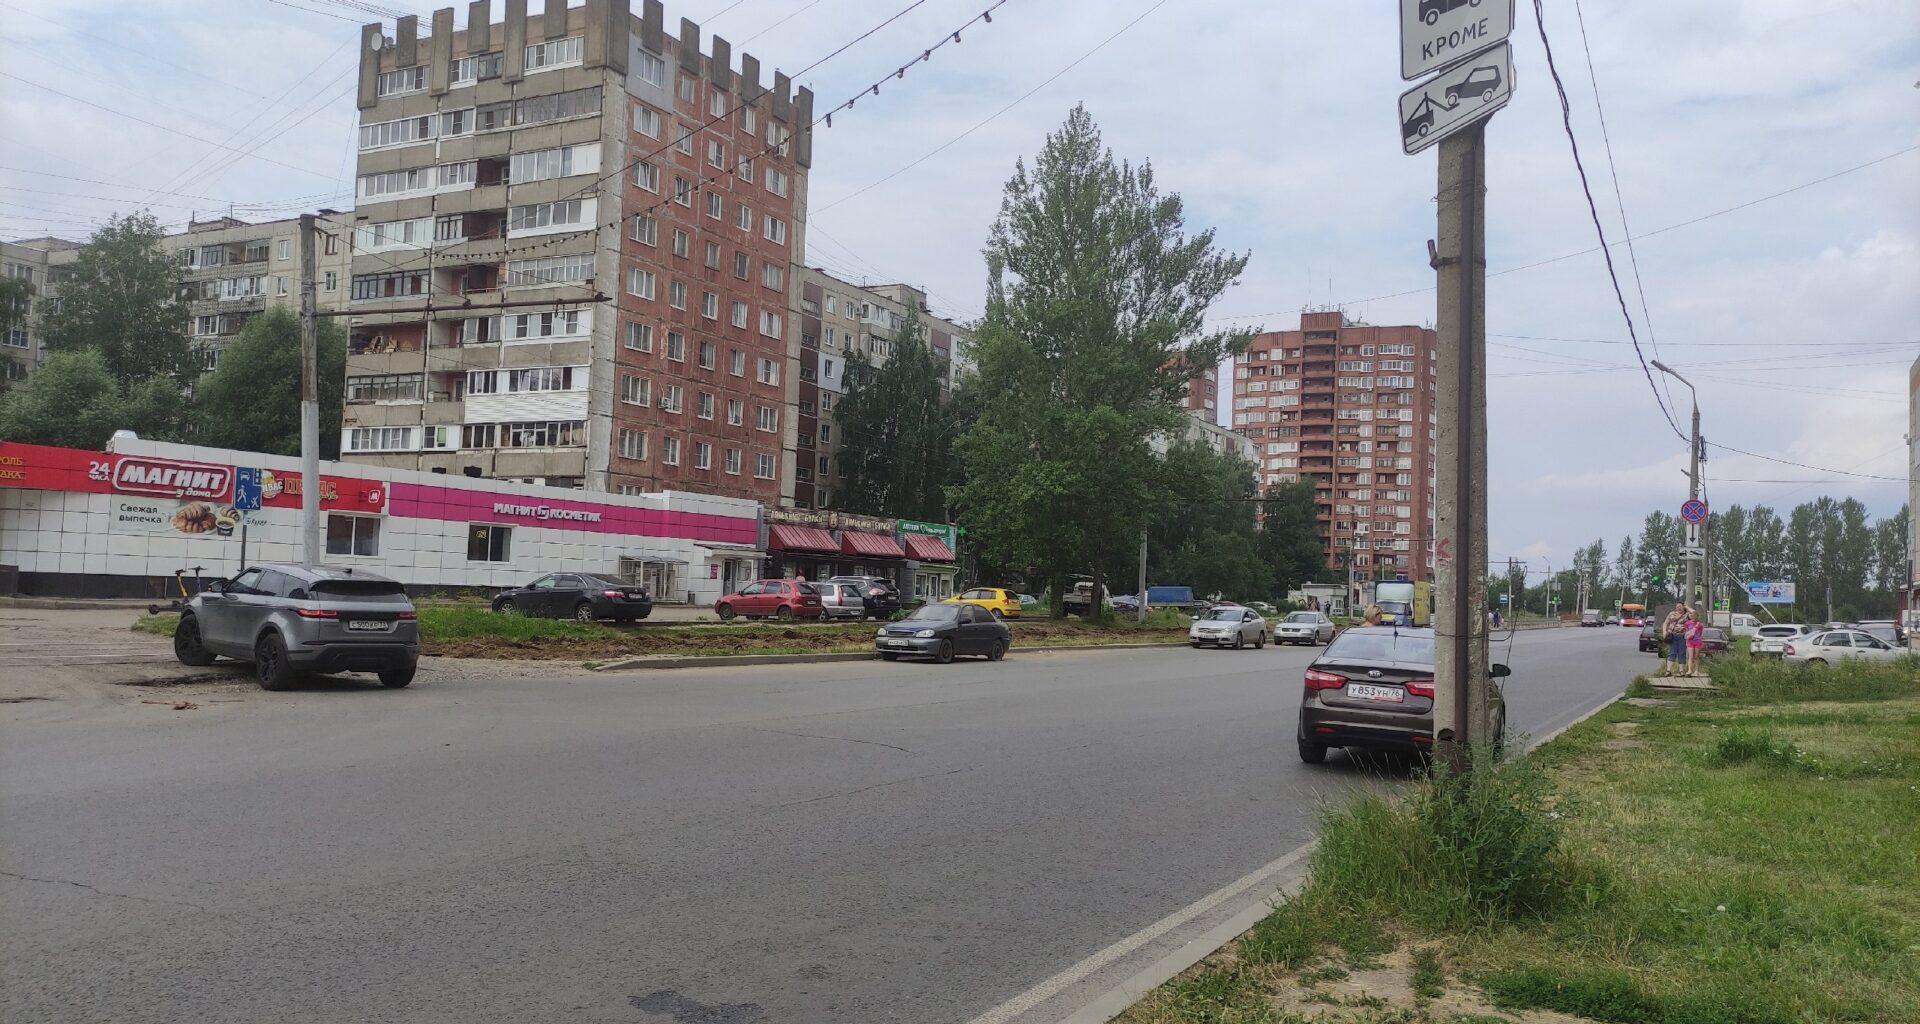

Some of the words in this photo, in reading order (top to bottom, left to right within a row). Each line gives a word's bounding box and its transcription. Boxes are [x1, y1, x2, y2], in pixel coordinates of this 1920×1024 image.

[1422, 17, 1488, 60] КРОМЕ
[89, 461, 110, 475] 24
[120, 465, 224, 490] МАГНИТ
[120, 503, 158, 514] Свежая
[493, 503, 537, 516] МАГНИТ
[549, 509, 601, 522] КОСМЕТИК
[119, 515, 162, 524] выпечка
